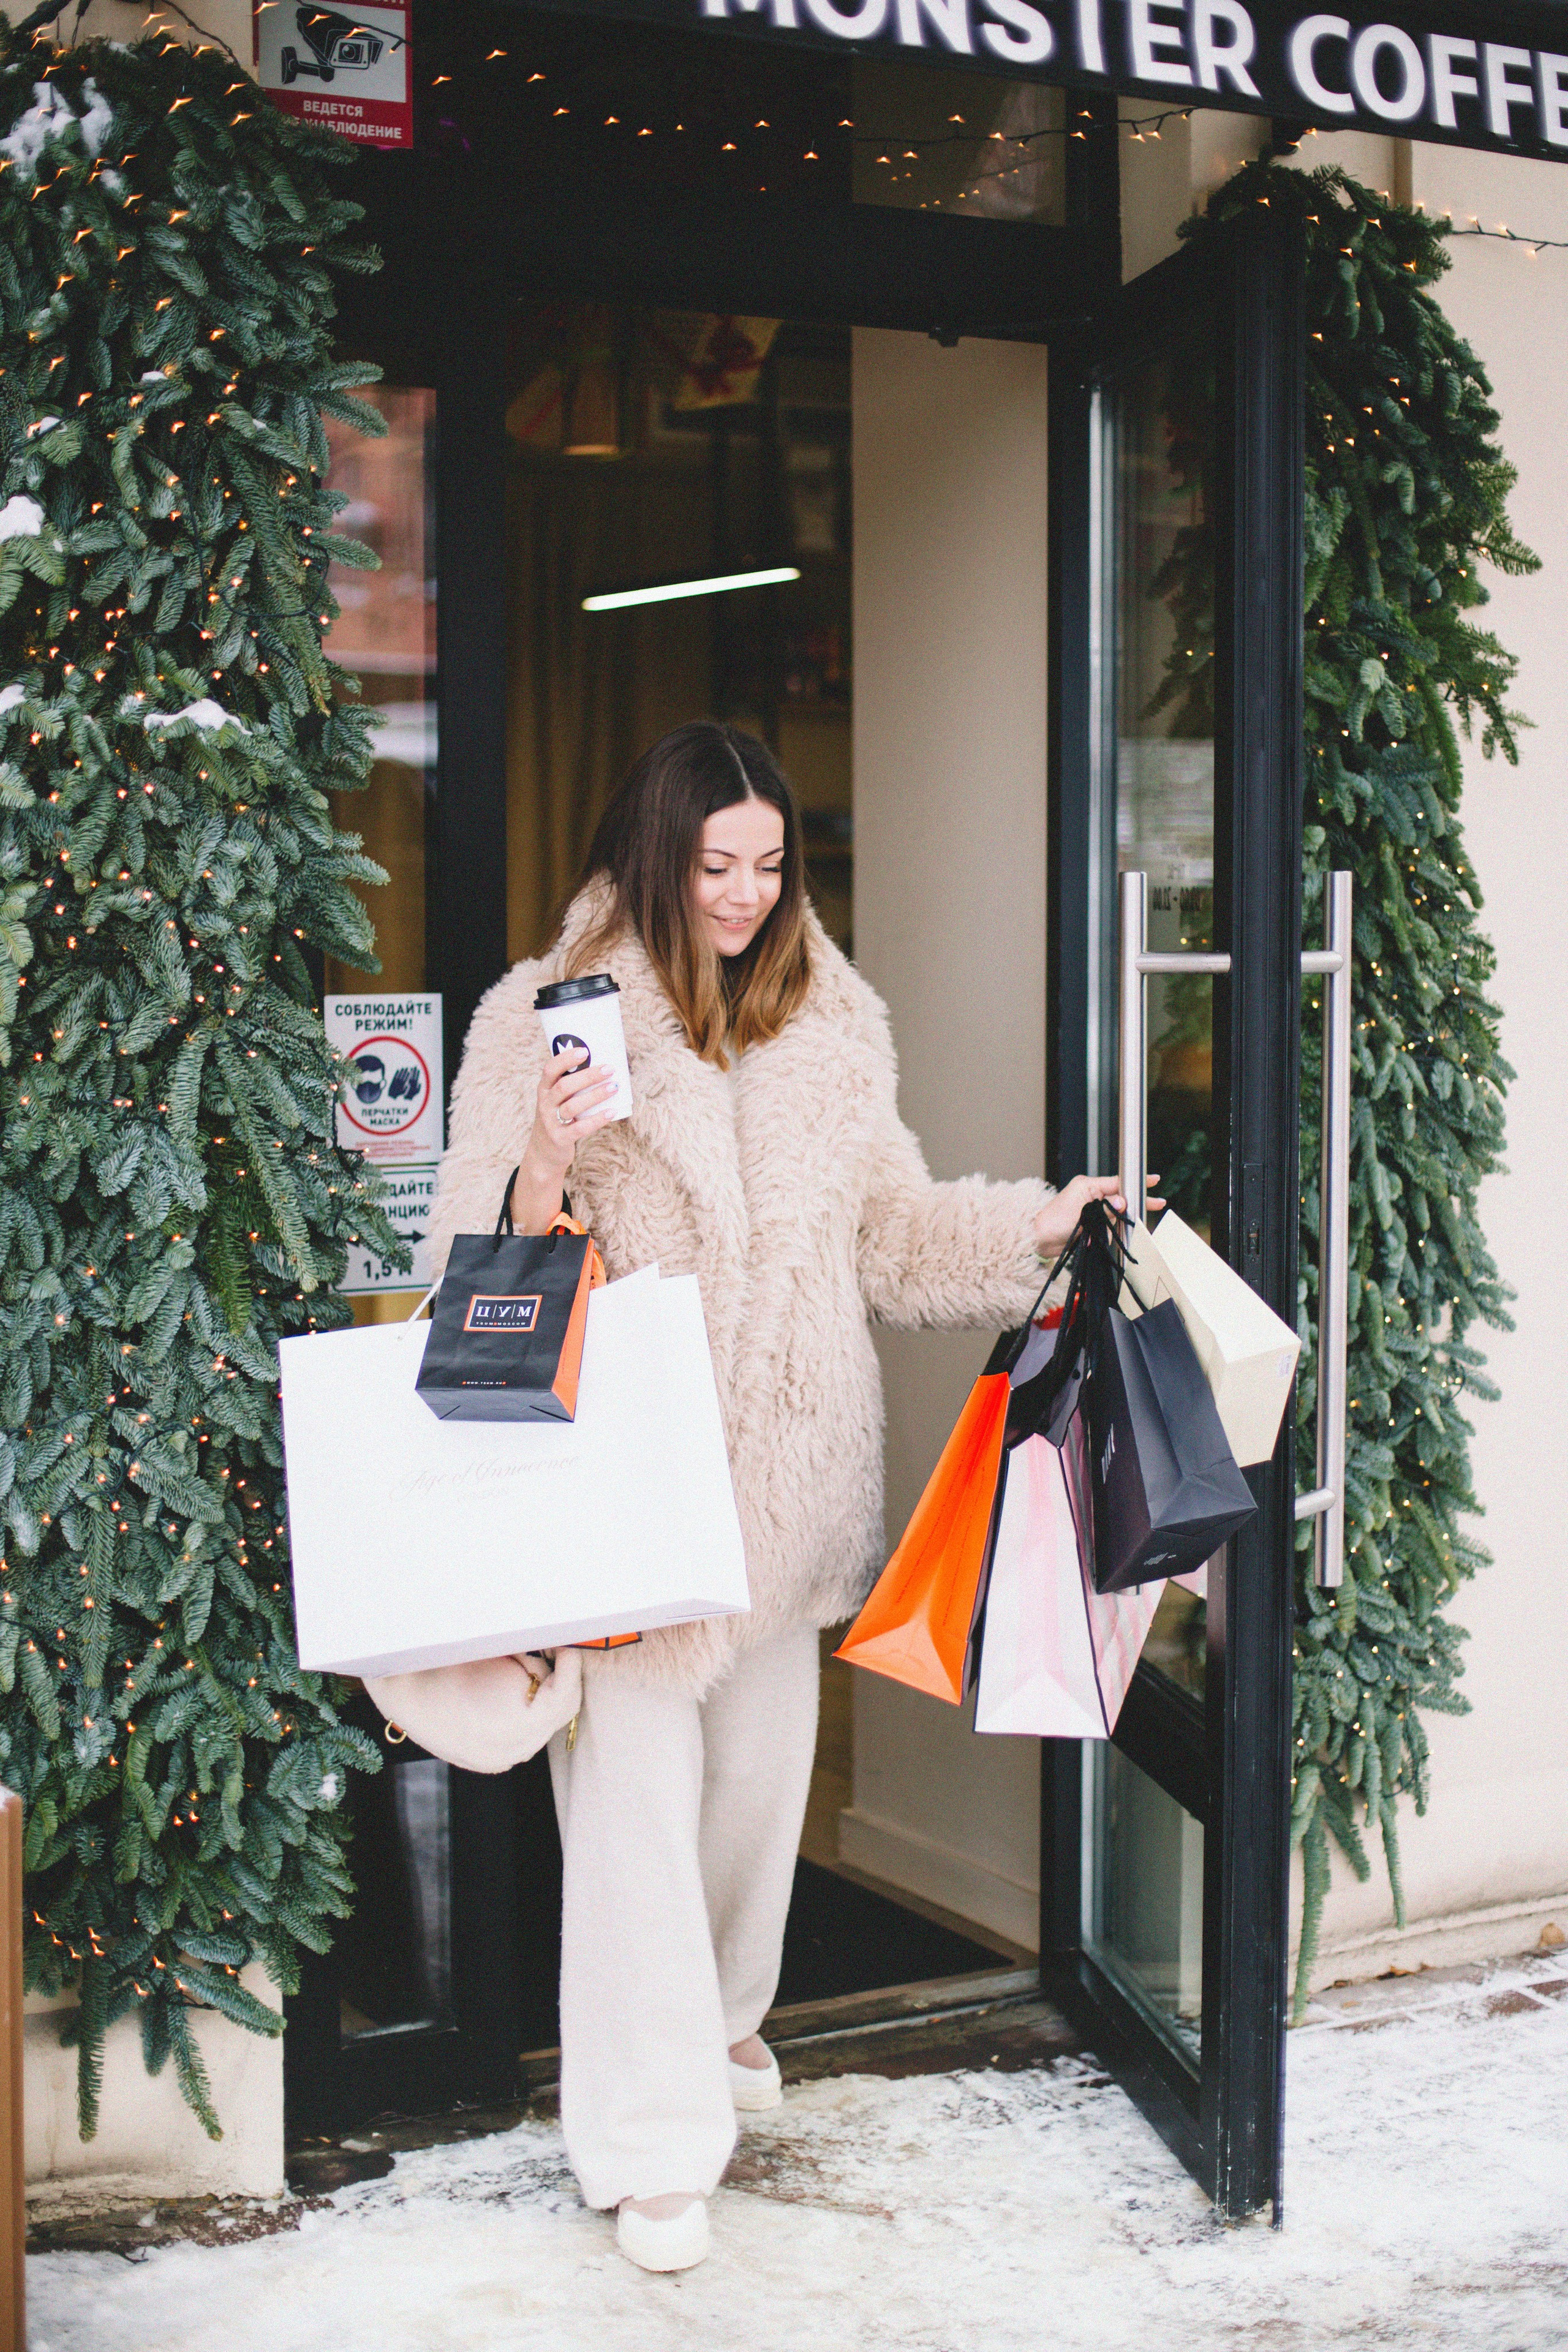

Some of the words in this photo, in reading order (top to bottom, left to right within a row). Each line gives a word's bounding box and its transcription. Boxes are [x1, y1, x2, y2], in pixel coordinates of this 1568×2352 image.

[303, 100, 363, 117] ВЕДЕТСЯ
[335, 1000, 432, 1017] СОБЛЮДАЙТЕ
[355, 1018, 412, 1031] РЕЖИМ!
[361, 1107, 409, 1116] ПЕРЧАТКИ
